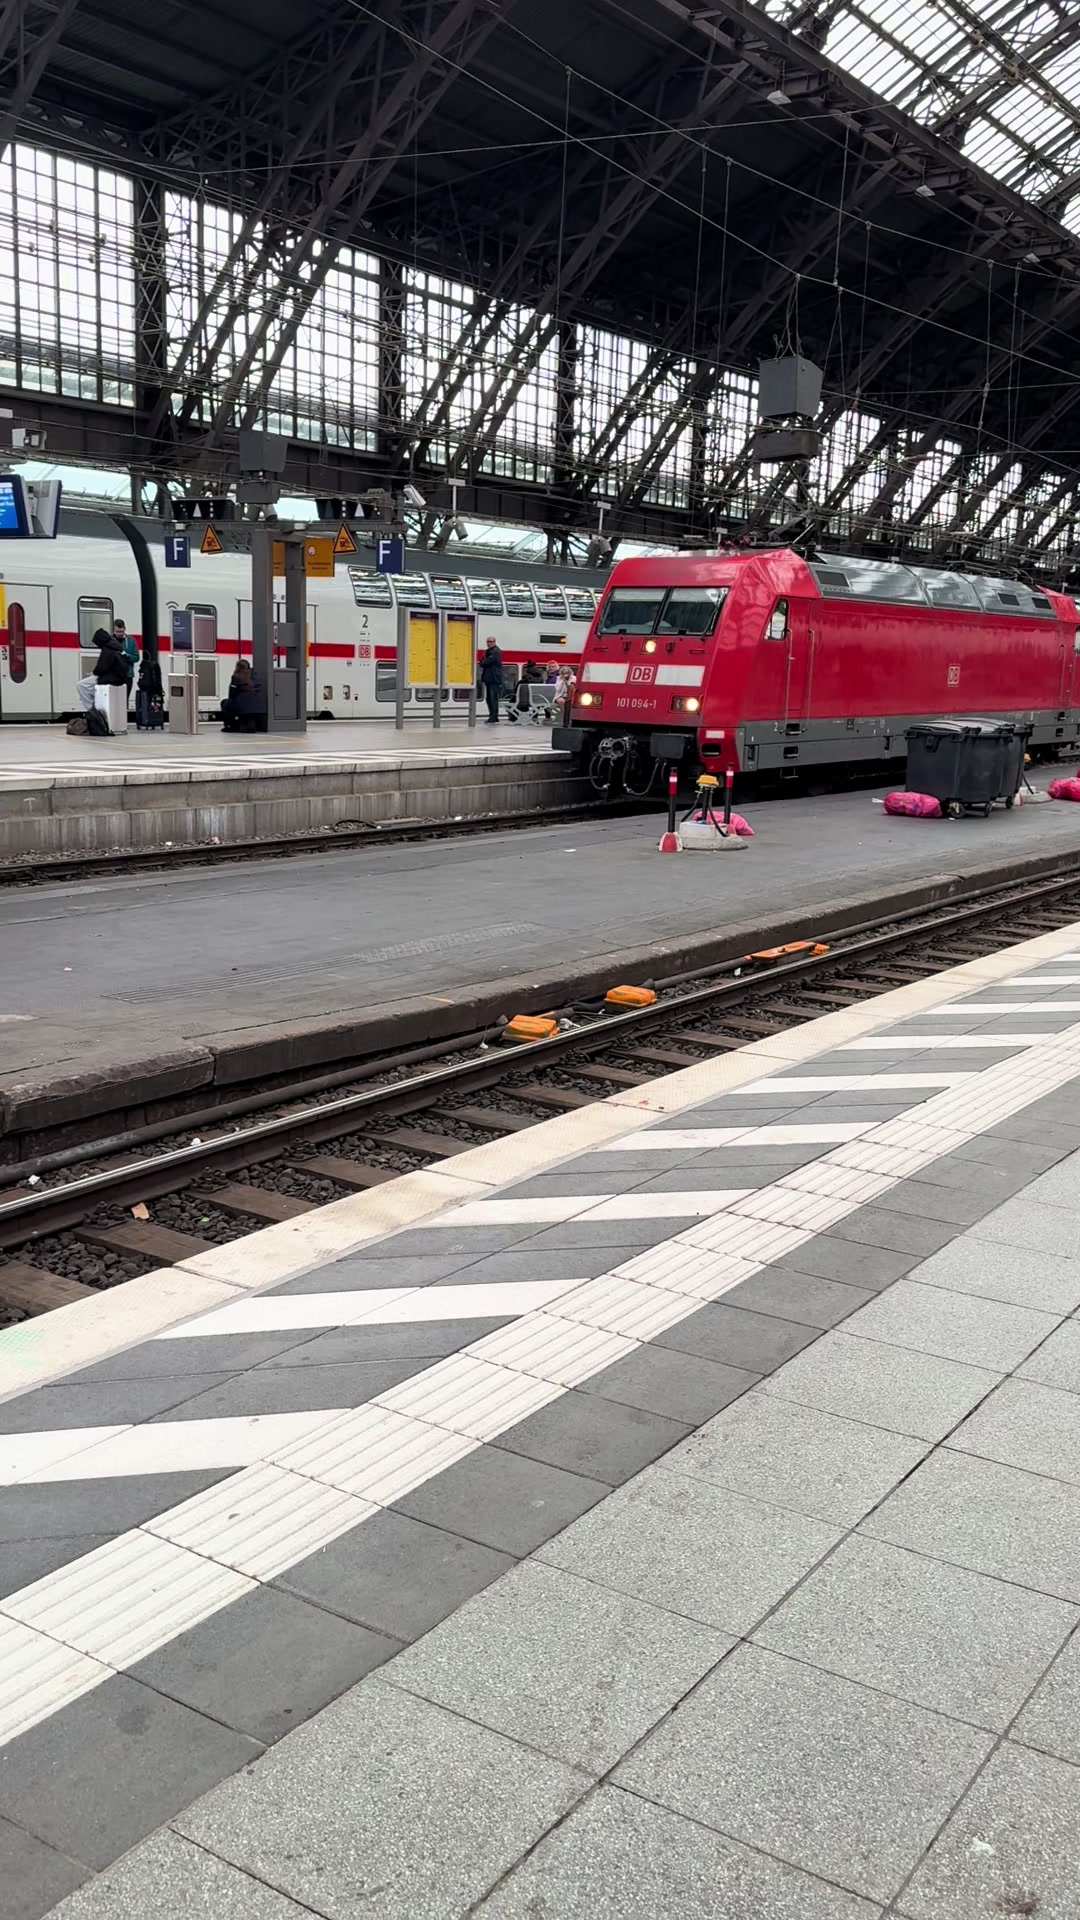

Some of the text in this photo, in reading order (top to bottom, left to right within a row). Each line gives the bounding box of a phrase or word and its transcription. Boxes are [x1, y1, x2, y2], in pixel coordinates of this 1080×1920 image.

[173, 538, 184, 560] F
[379, 540, 391, 565] F
[362, 614, 369, 629] 2
[360, 646, 370, 657] DB
[632, 667, 652, 681] DB
[949, 667, 959, 682] DB
